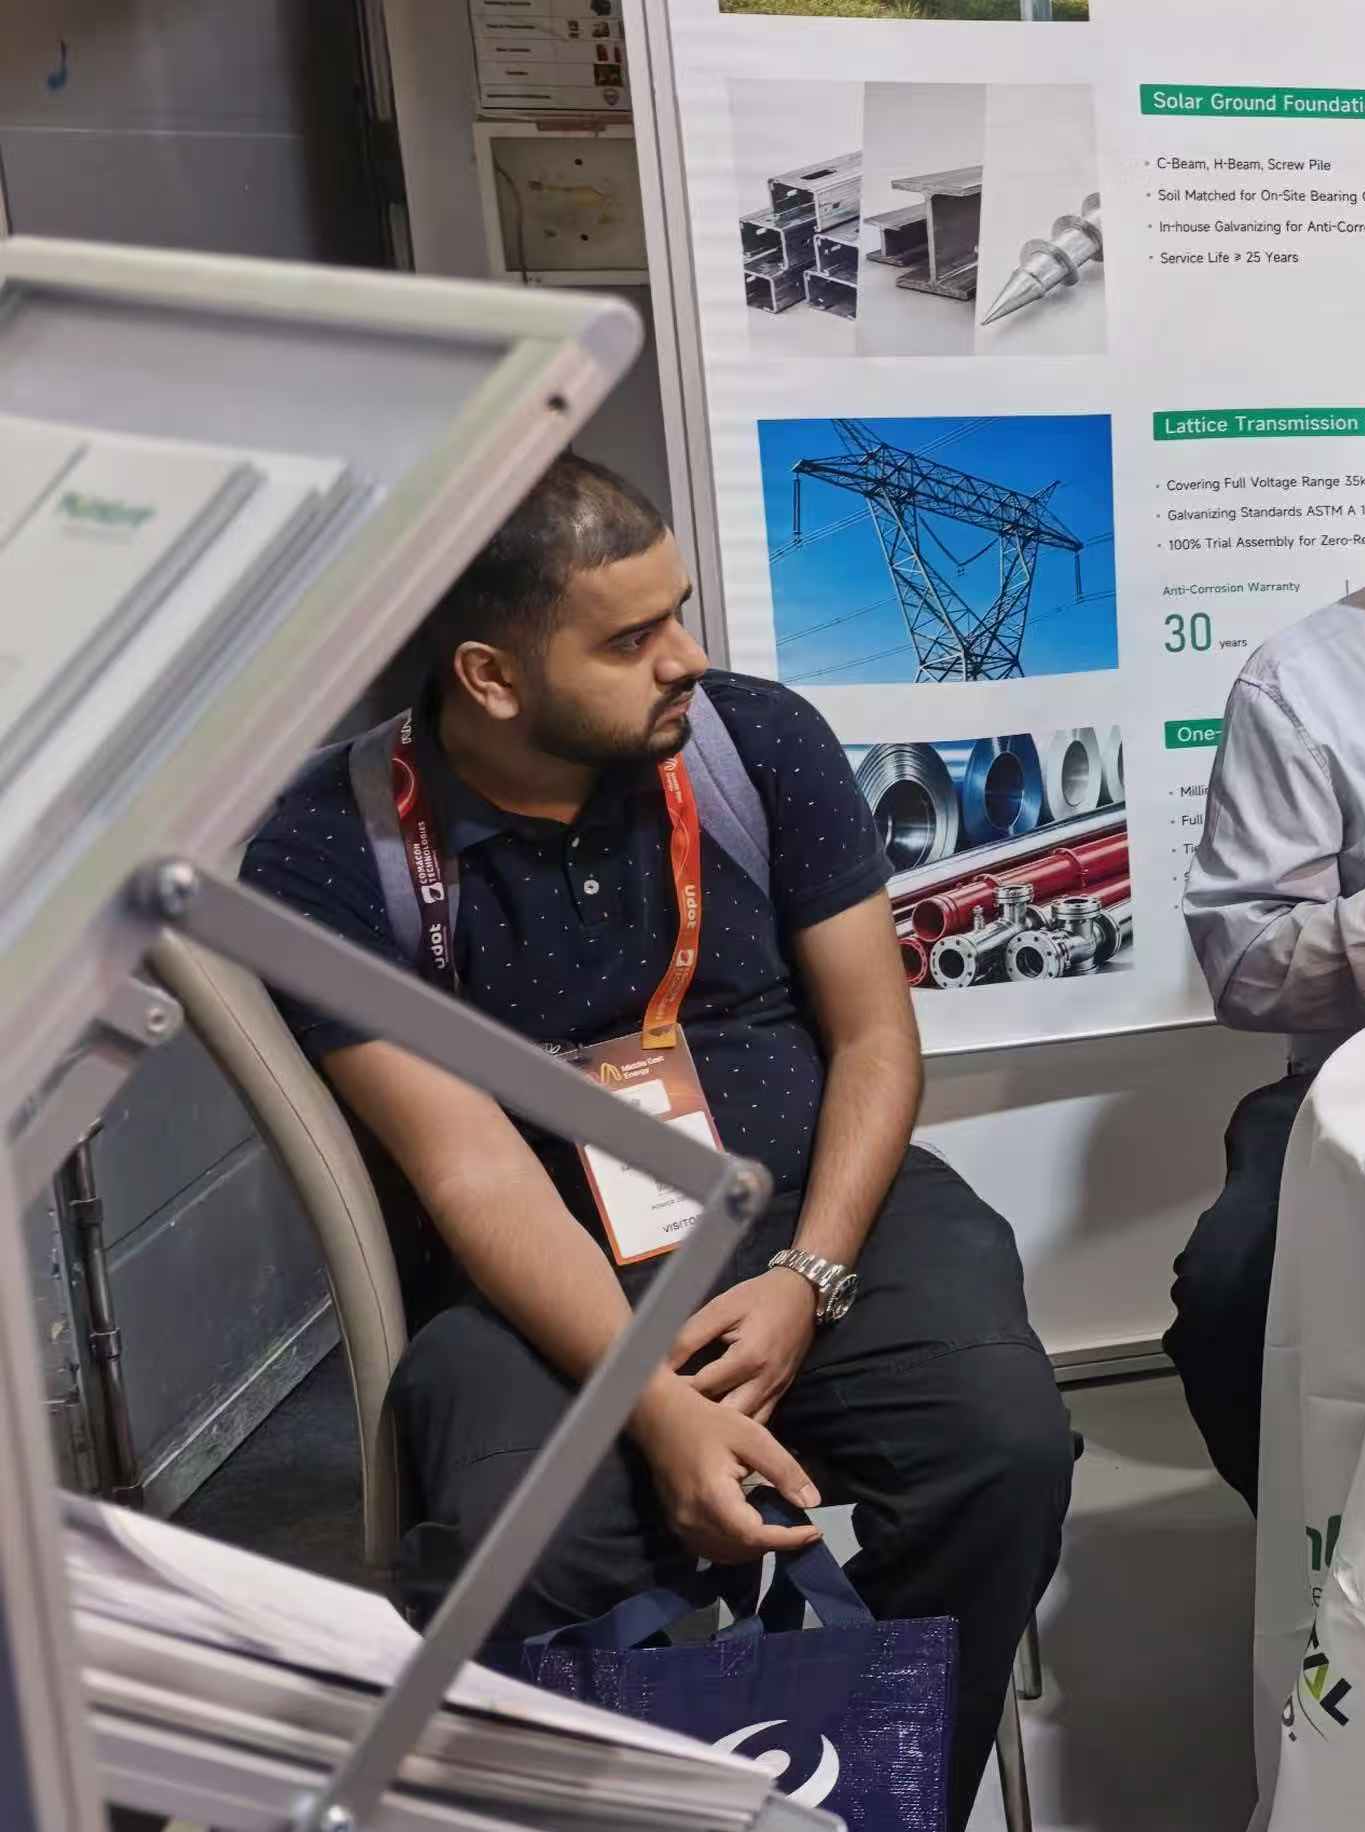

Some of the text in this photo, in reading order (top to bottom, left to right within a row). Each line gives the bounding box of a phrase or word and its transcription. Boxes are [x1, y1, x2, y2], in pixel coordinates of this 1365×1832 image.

[1153, 91, 1204, 111] Solar
[1211, 93, 1276, 112] Ground
[1157, 157, 1331, 172] C-Beam, H-Beam, Screw Pile
[1158, 189, 1181, 202] Soil
[1185, 189, 1236, 203] Matched
[1240, 189, 1257, 203] for
[1260, 190, 1306, 203] On-Site
[1310, 191, 1358, 206] Bearing
[1214, 221, 1282, 236] Galvanizing
[1285, 222, 1303, 235] for
[1160, 252, 1204, 266] Service
[1208, 252, 1230, 265] Life
[1246, 252, 1261, 265] 25
[1266, 252, 1299, 265] Years
[1165, 415, 1359, 434] Lattice Transmission
[1166, 478, 1220, 493] Covering
[1224, 476, 1247, 489] Full
[1251, 476, 1298, 491] Voltage
[1302, 474, 1340, 489] Range
[1168, 509, 1237, 522] Galvanizing
[1240, 506, 1303, 518] Standards
[1306, 505, 1344, 518] ASTM
[1348, 505, 1356, 516] A
[1168, 538, 1201, 551] 100%
[1206, 537, 1232, 550] Trial
[1236, 536, 1294, 550] Assembly
[1299, 534, 1316, 547] for
[1163, 582, 1301, 595] Anti-Corrosion Warranty
[1164, 612, 1248, 653] 30 years
